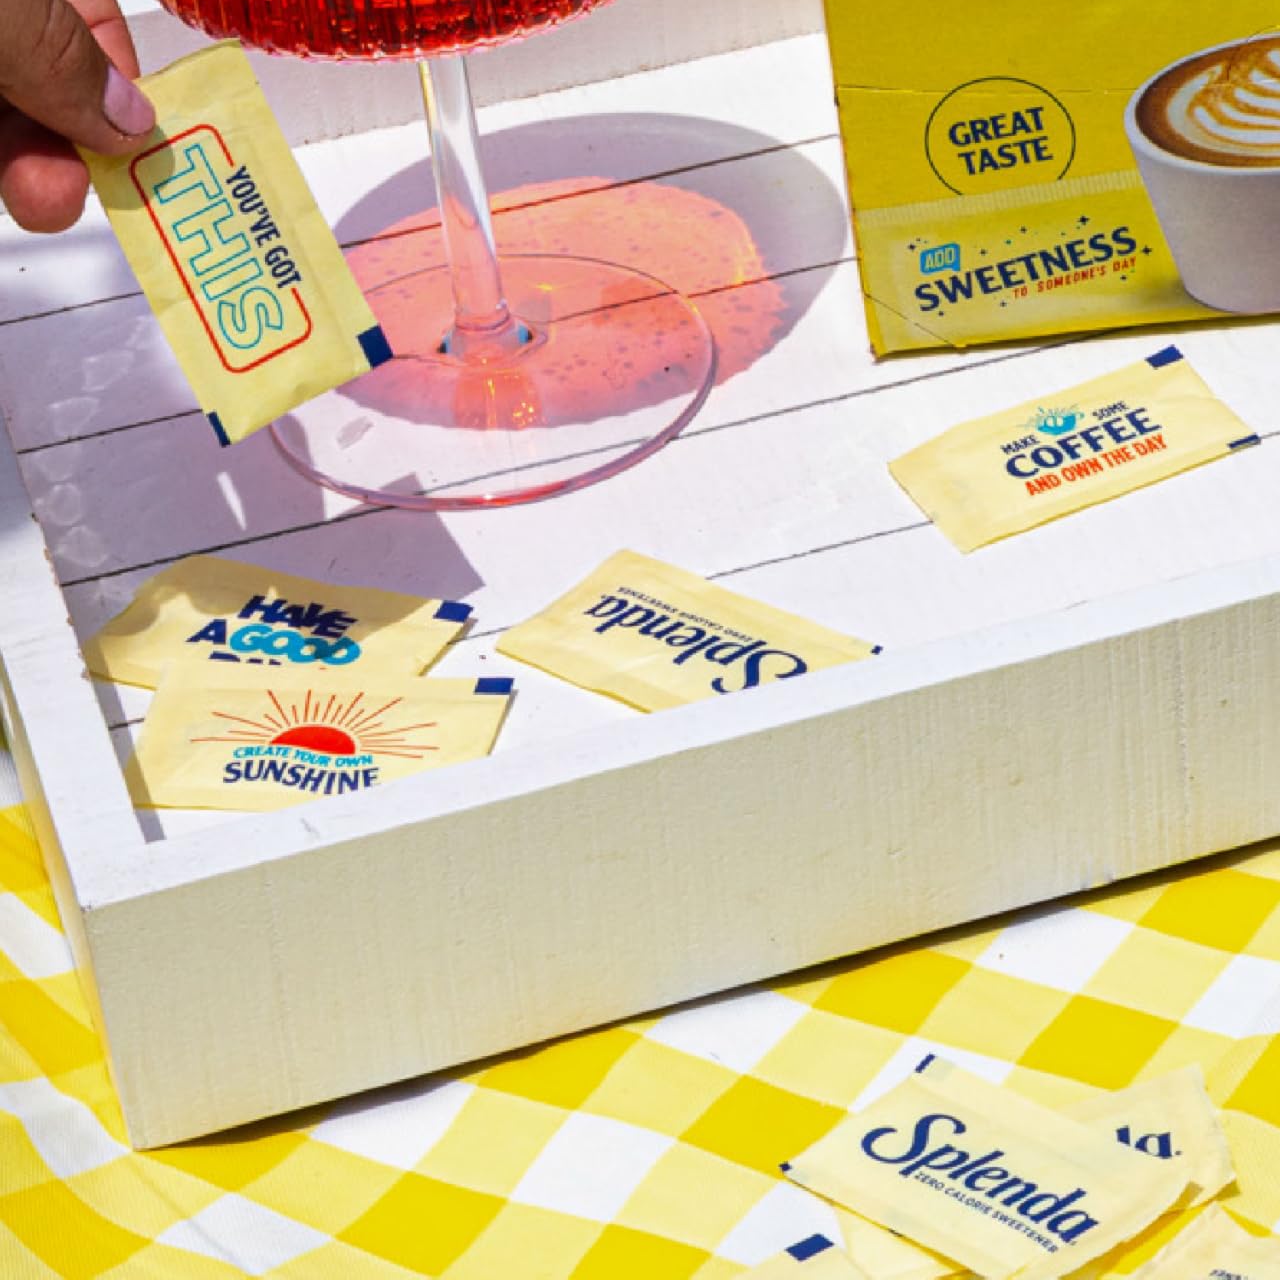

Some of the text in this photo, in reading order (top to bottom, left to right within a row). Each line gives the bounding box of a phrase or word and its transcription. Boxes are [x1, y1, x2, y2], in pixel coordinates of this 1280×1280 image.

[948, 106, 1044, 147] GREAT
[957, 136, 1054, 176] TASTE
[153, 143, 283, 350] THIS
[226, 166, 303, 289] YOU'VE GOT
[914, 226, 1138, 312] SWEETNESS
[924, 246, 957, 271] ADD
[1012, 255, 1137, 300] TO SOMEONE'S DAY
[1002, 400, 1130, 454] MAKE SOME
[1006, 407, 1163, 478] COFFEE
[1025, 433, 1168, 497] AND OWN THE DAY
[185, 618, 228, 645] A
[228, 623, 363, 666] GOOD
[237, 595, 360, 639] HAVE
[584, 593, 808, 695] Splenda
[223, 758, 382, 795] SUNSHINE
[233, 745, 373, 768] CREATE YOUR OWN
[860, 1113, 1100, 1243] Splenda
[914, 1171, 1060, 1253] ZERO CALORIE SWEETENER
